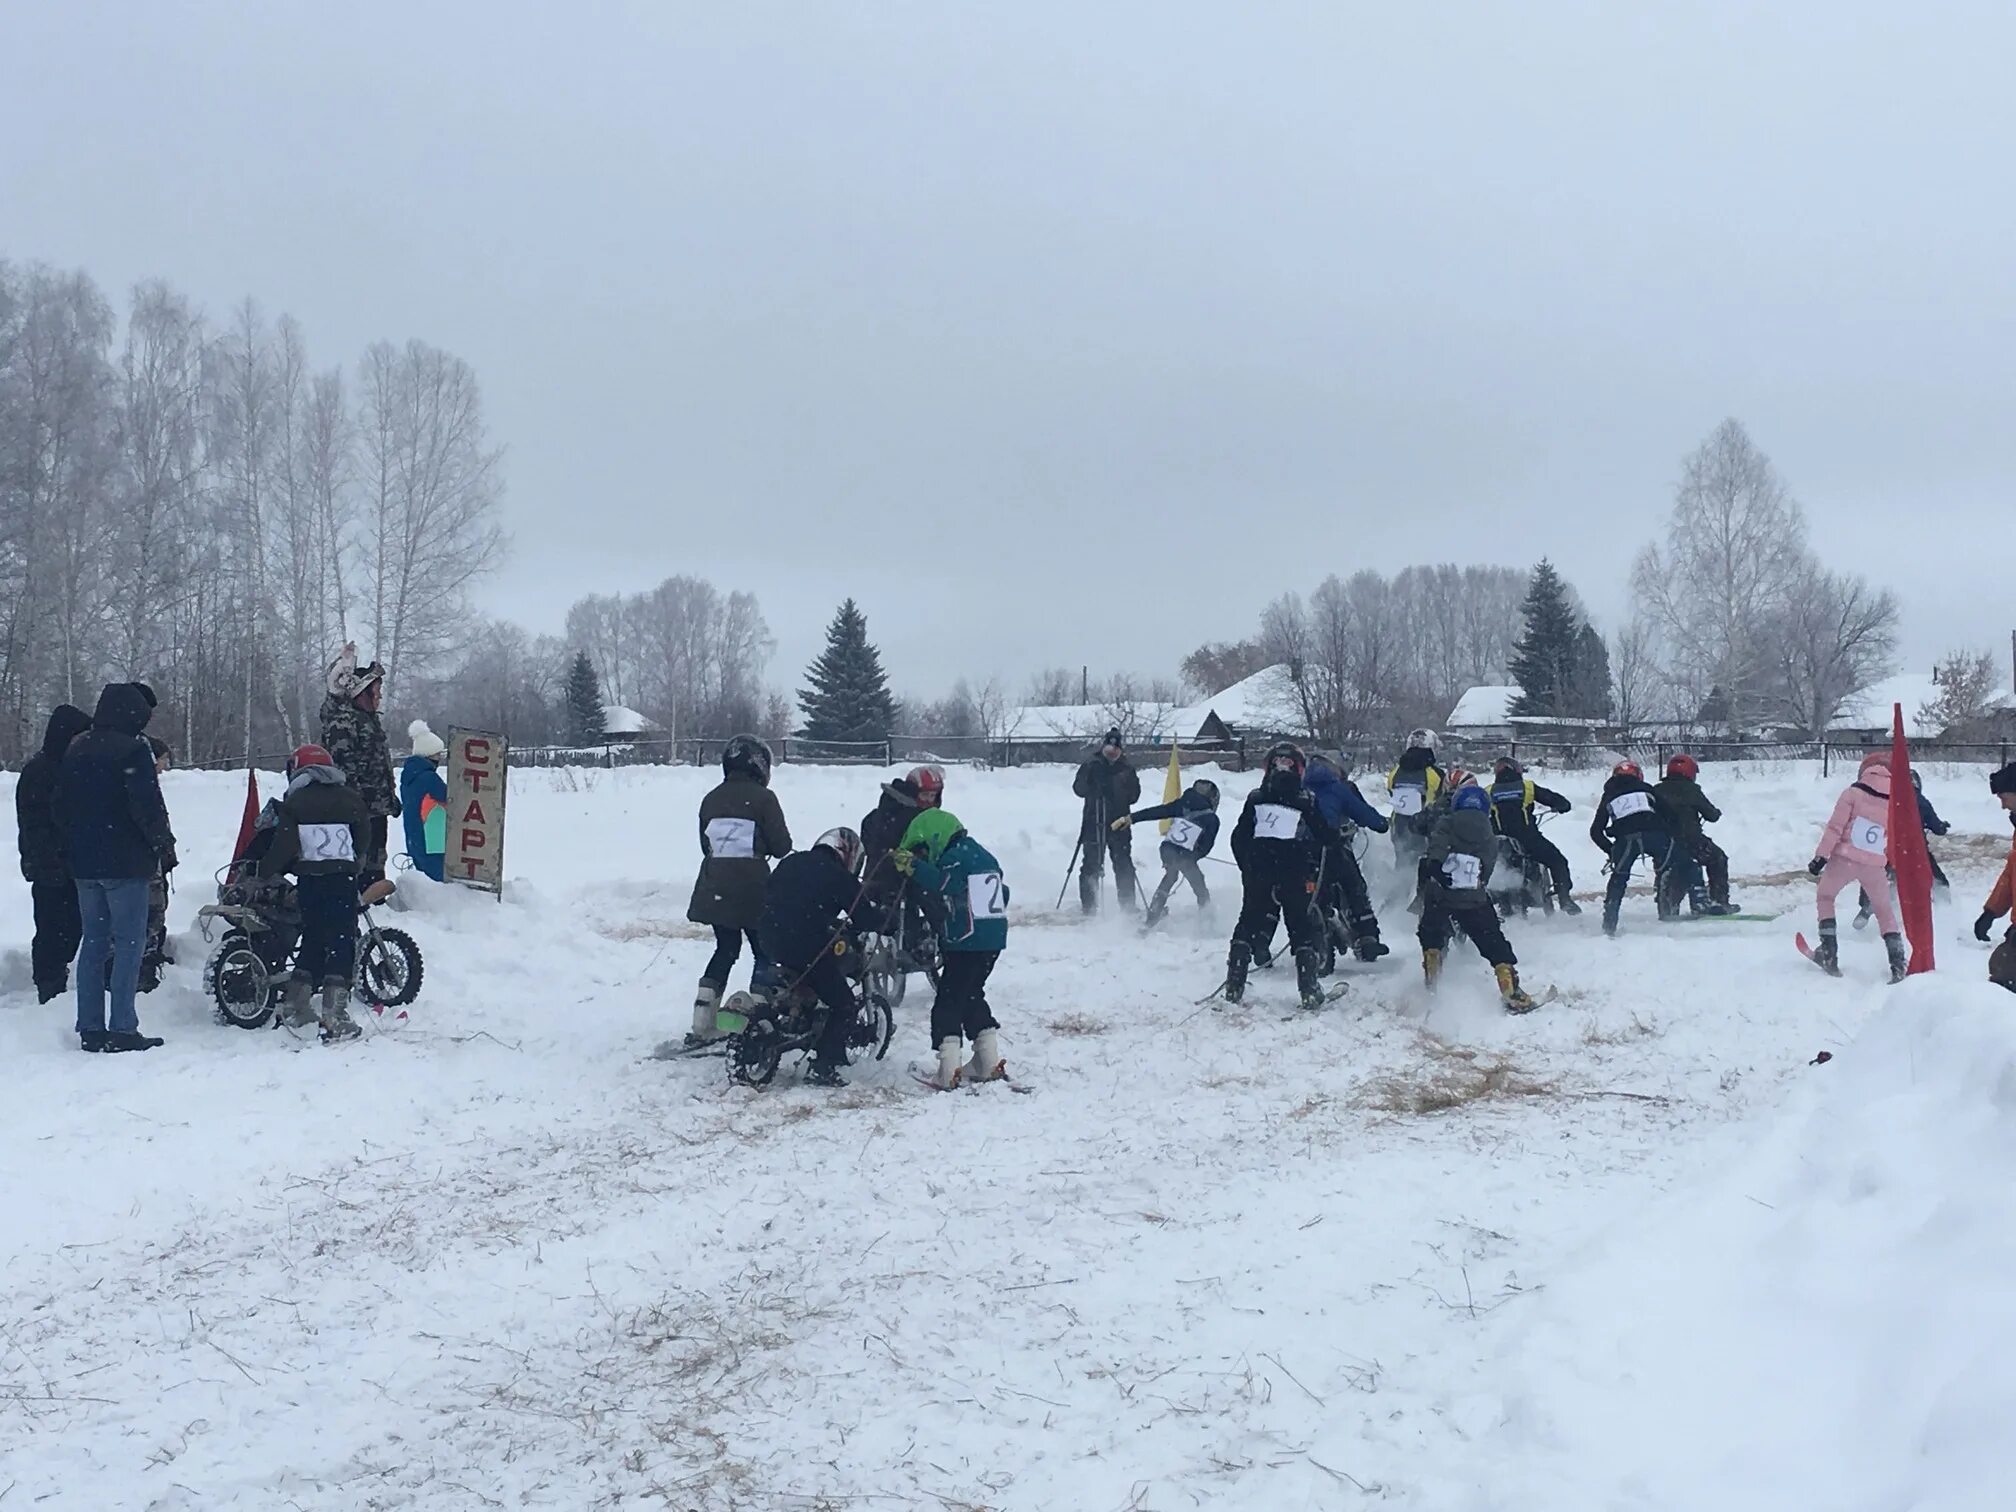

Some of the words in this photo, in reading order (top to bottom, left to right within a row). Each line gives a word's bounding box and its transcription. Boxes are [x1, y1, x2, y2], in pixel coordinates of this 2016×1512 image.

[461, 738, 490, 880] СТАРТ
[1399, 794, 1409, 809] 5
[1170, 820, 1193, 844] 3
[1265, 811, 1280, 829] 4
[313, 827, 349, 857] 28
[1865, 825, 1881, 844] 6
[984, 874, 1003, 914] 2
